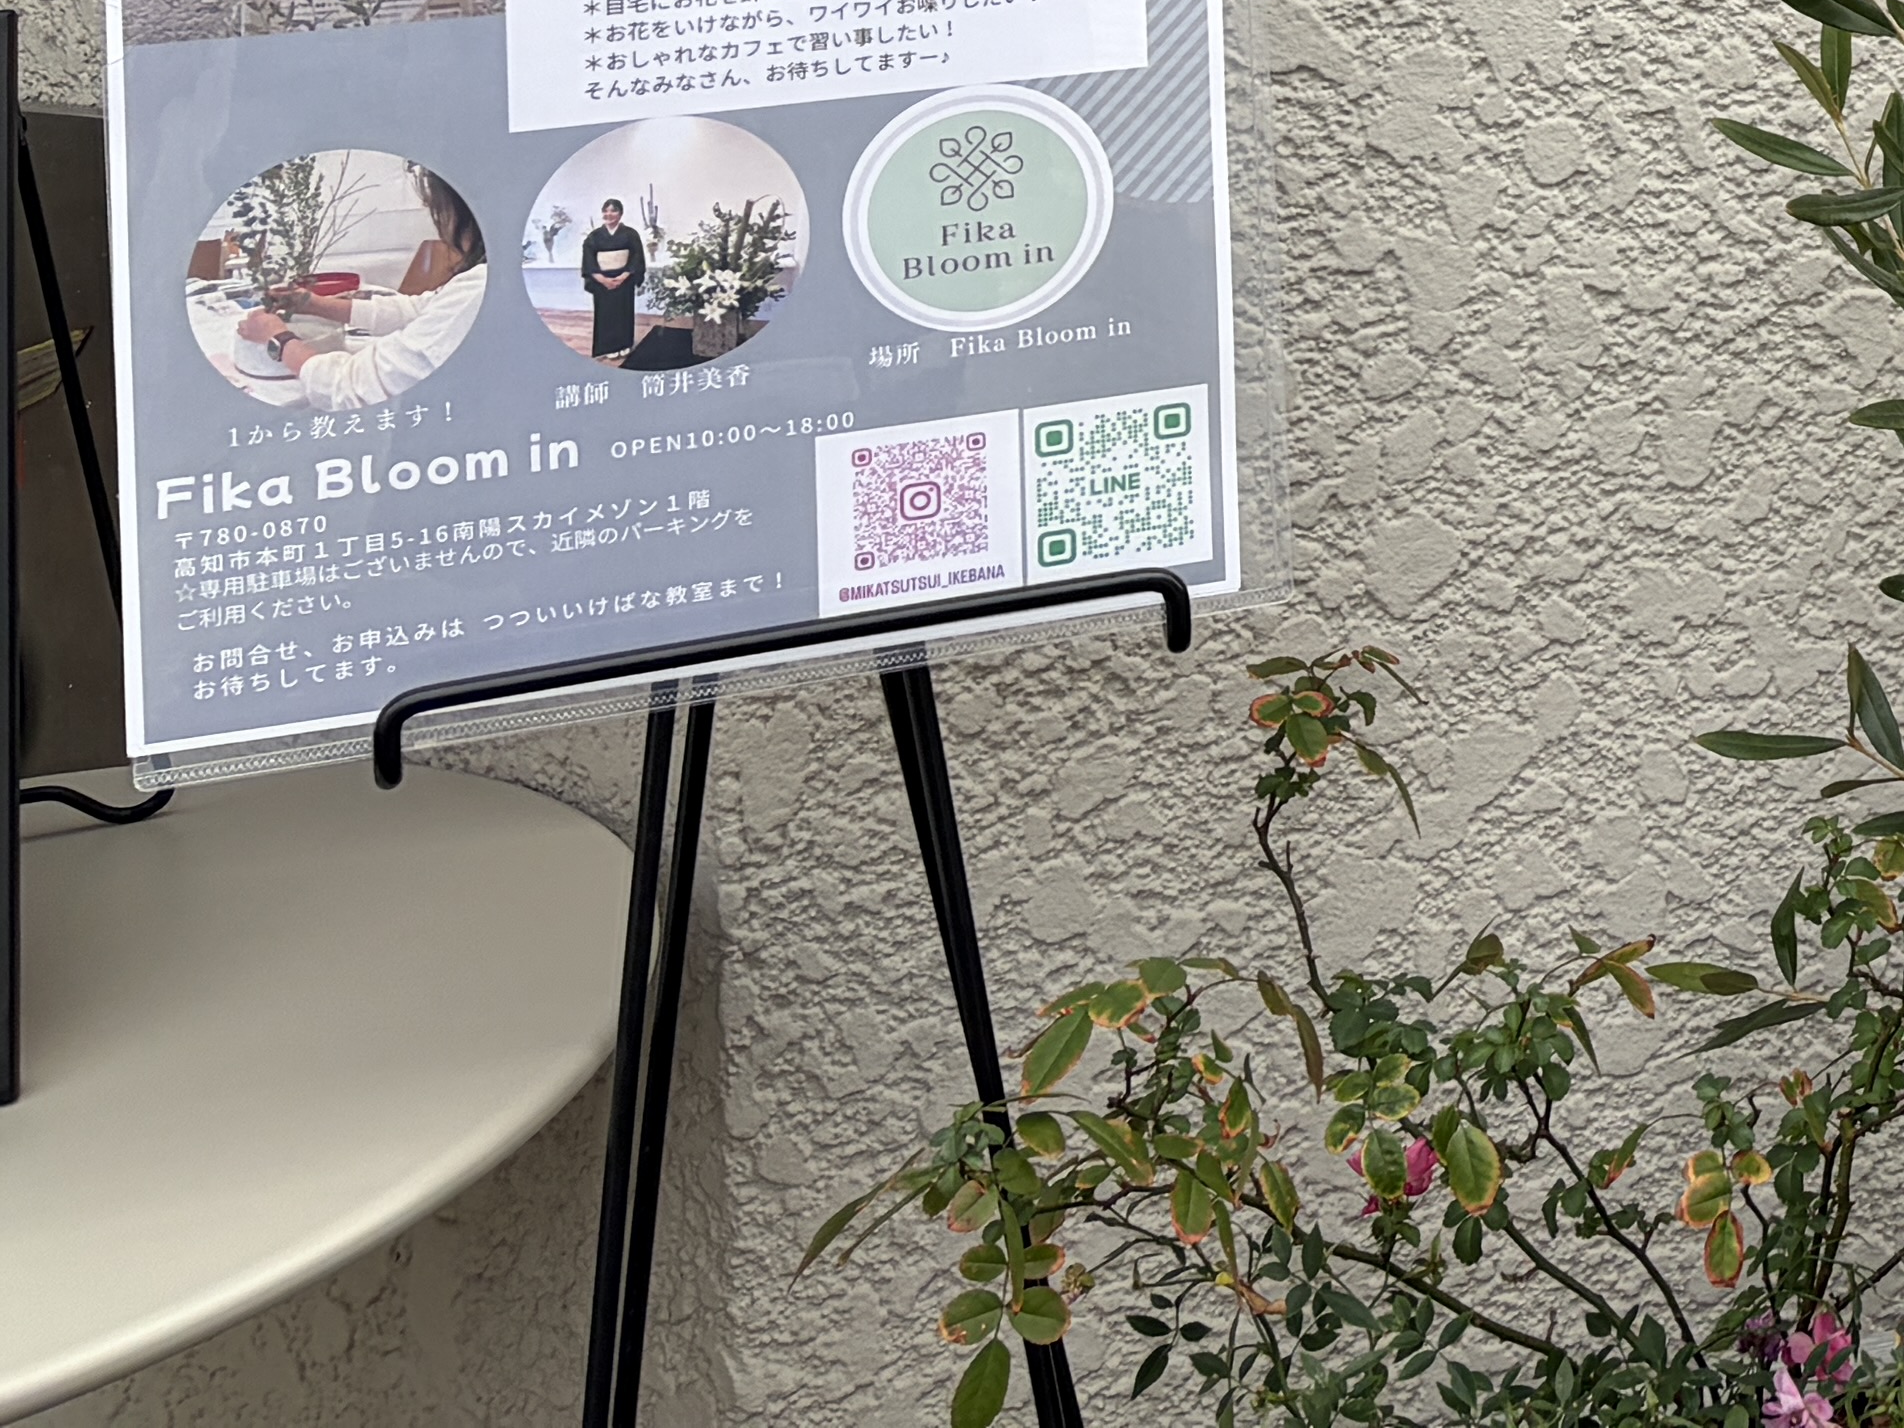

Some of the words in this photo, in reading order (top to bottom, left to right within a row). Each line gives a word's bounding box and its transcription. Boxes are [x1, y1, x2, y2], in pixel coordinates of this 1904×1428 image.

[941, 219, 1017, 246] Fika
[903, 248, 1012, 280] Bloom
[1024, 242, 1055, 266] in
[869, 341, 920, 369] 場所
[950, 336, 1006, 359] Fika
[1017, 322, 1097, 350] Bloom
[1108, 317, 1132, 337] in
[555, 380, 610, 409] 講師
[155, 471, 293, 520] Fika
[316, 446, 509, 499] Bloom
[530, 432, 579, 472] in
[1090, 472, 1141, 497] LINE
[838, 564, 1006, 602] @MIKATSUTSUI_IKEBANA
[177, 595, 352, 632] ご利用ください。
[193, 657, 397, 700] お待ちしてます。
